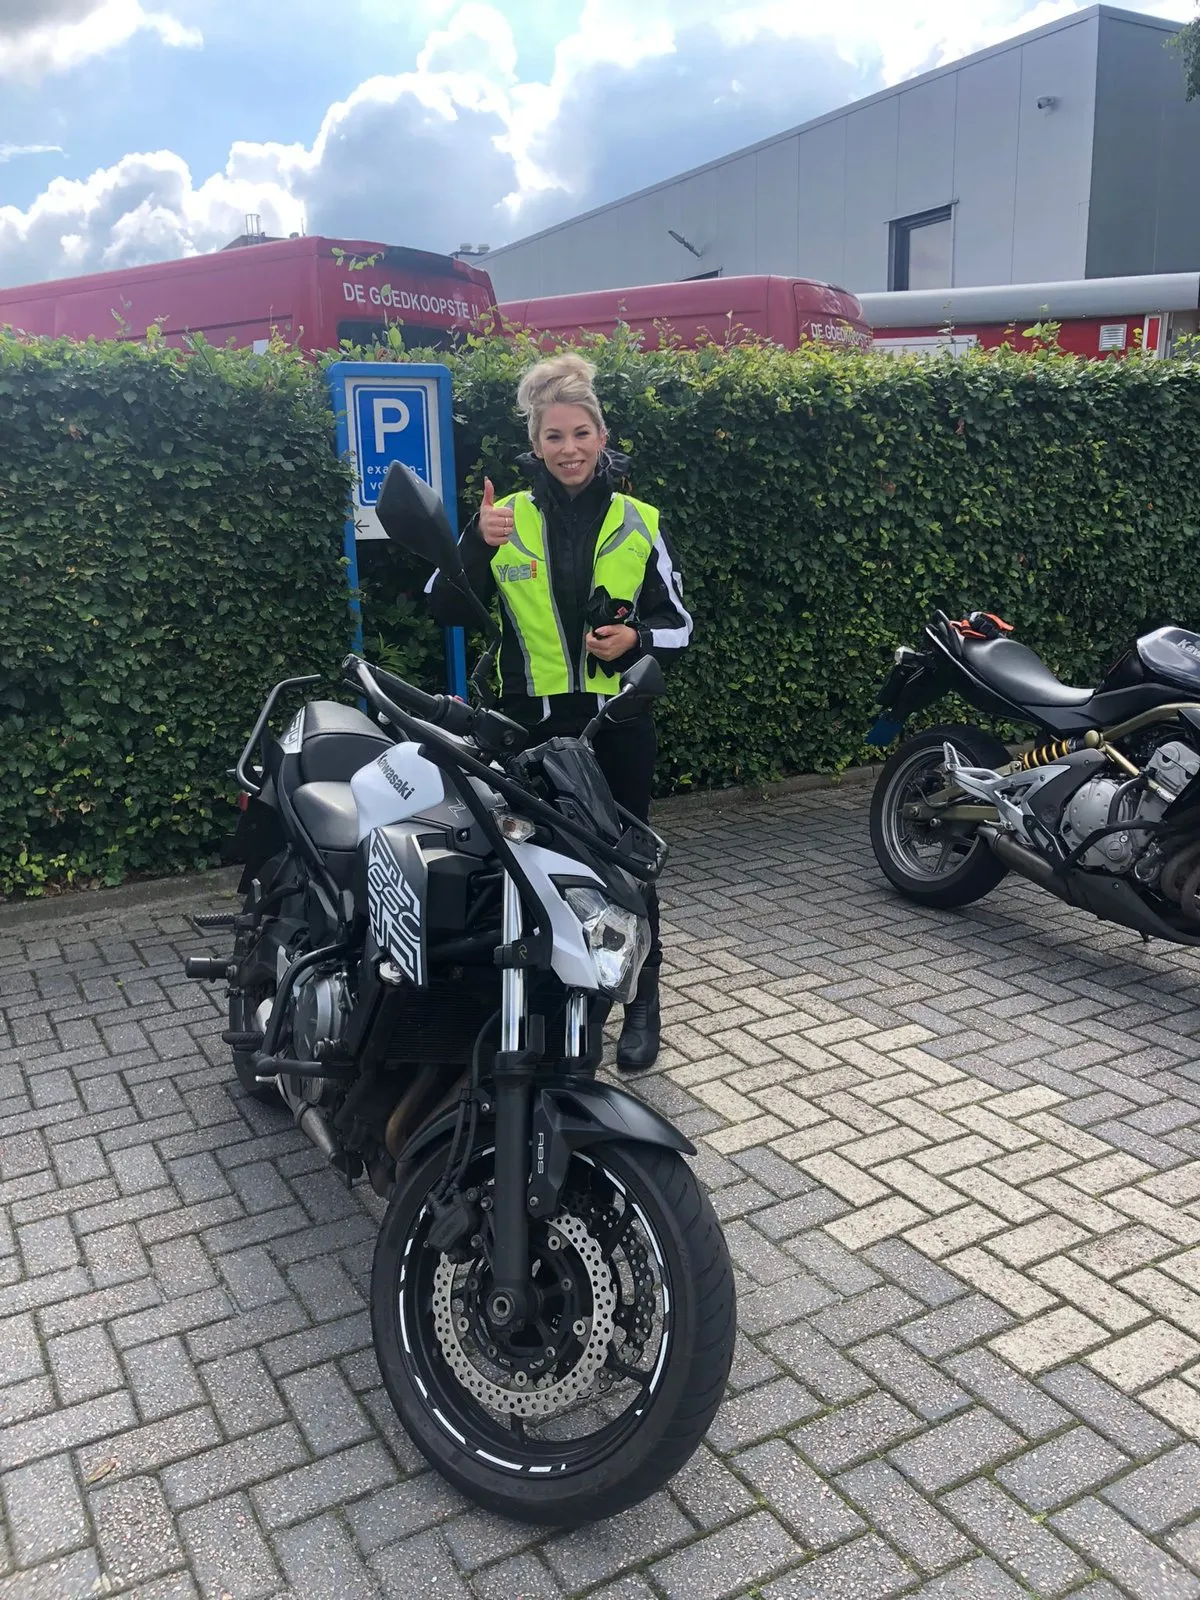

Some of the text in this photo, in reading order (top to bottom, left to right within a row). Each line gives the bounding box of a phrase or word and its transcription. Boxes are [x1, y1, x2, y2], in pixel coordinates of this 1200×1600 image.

[342, 282, 366, 303] DE
[369, 286, 471, 319] GOEDKOOPSTE
[372, 398, 410, 453] P
[496, 560, 537, 582] Yes!
[376, 752, 416, 800] Kawasaki
[368, 865, 421, 941] 650
[537, 1132, 545, 1174] ABS
